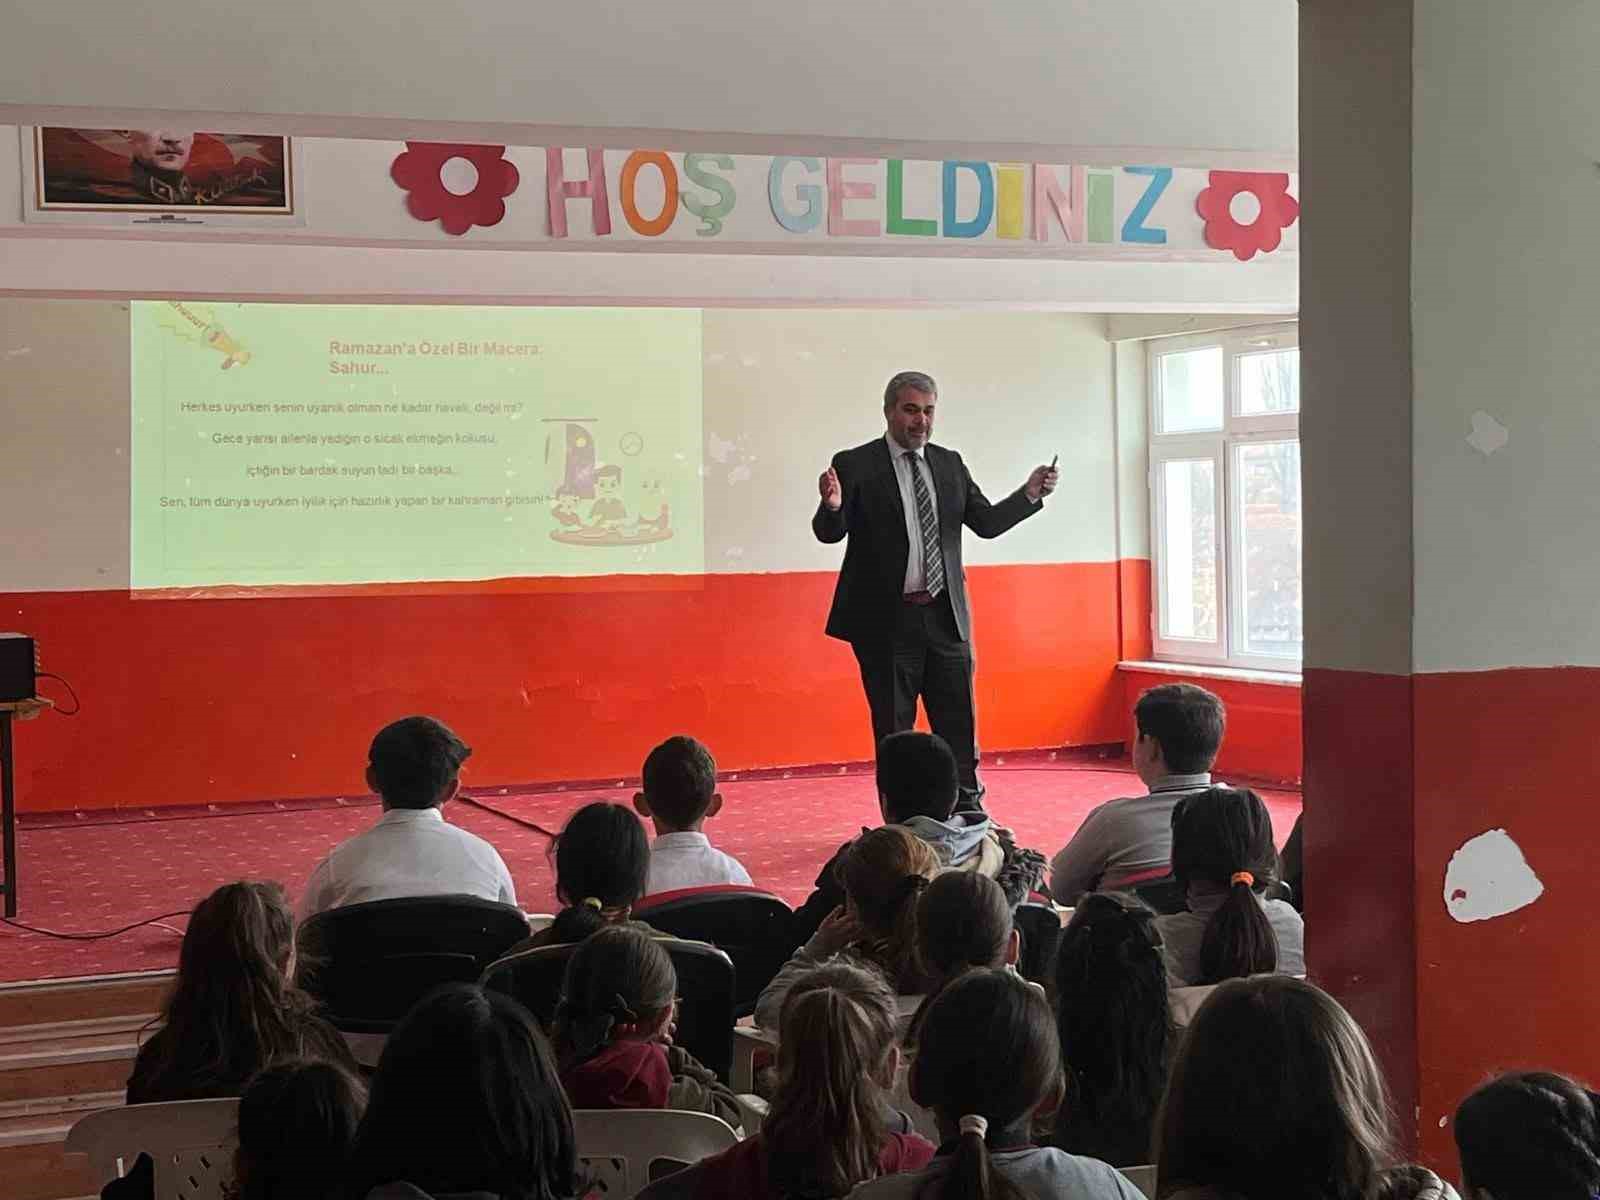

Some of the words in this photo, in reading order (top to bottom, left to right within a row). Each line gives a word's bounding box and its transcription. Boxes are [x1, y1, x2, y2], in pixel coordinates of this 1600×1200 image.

[546, 146, 736, 237] HOŞ
[329, 341, 416, 355] Ramazan'a
[419, 339, 454, 355] Özel
[457, 341, 480, 355] Bir
[329, 361, 390, 375] Sahur...
[181, 402, 222, 413] Herkes
[224, 402, 271, 415] uyurken
[274, 402, 304, 413] senin
[384, 404, 398, 413] ne
[212, 433, 243, 444] Gece
[282, 465, 297, 475] bir
[299, 465, 338, 475] bardak
[189, 496, 212, 507] tüm
[214, 496, 250, 509] dünya
[393, 496, 429, 509] yapan
